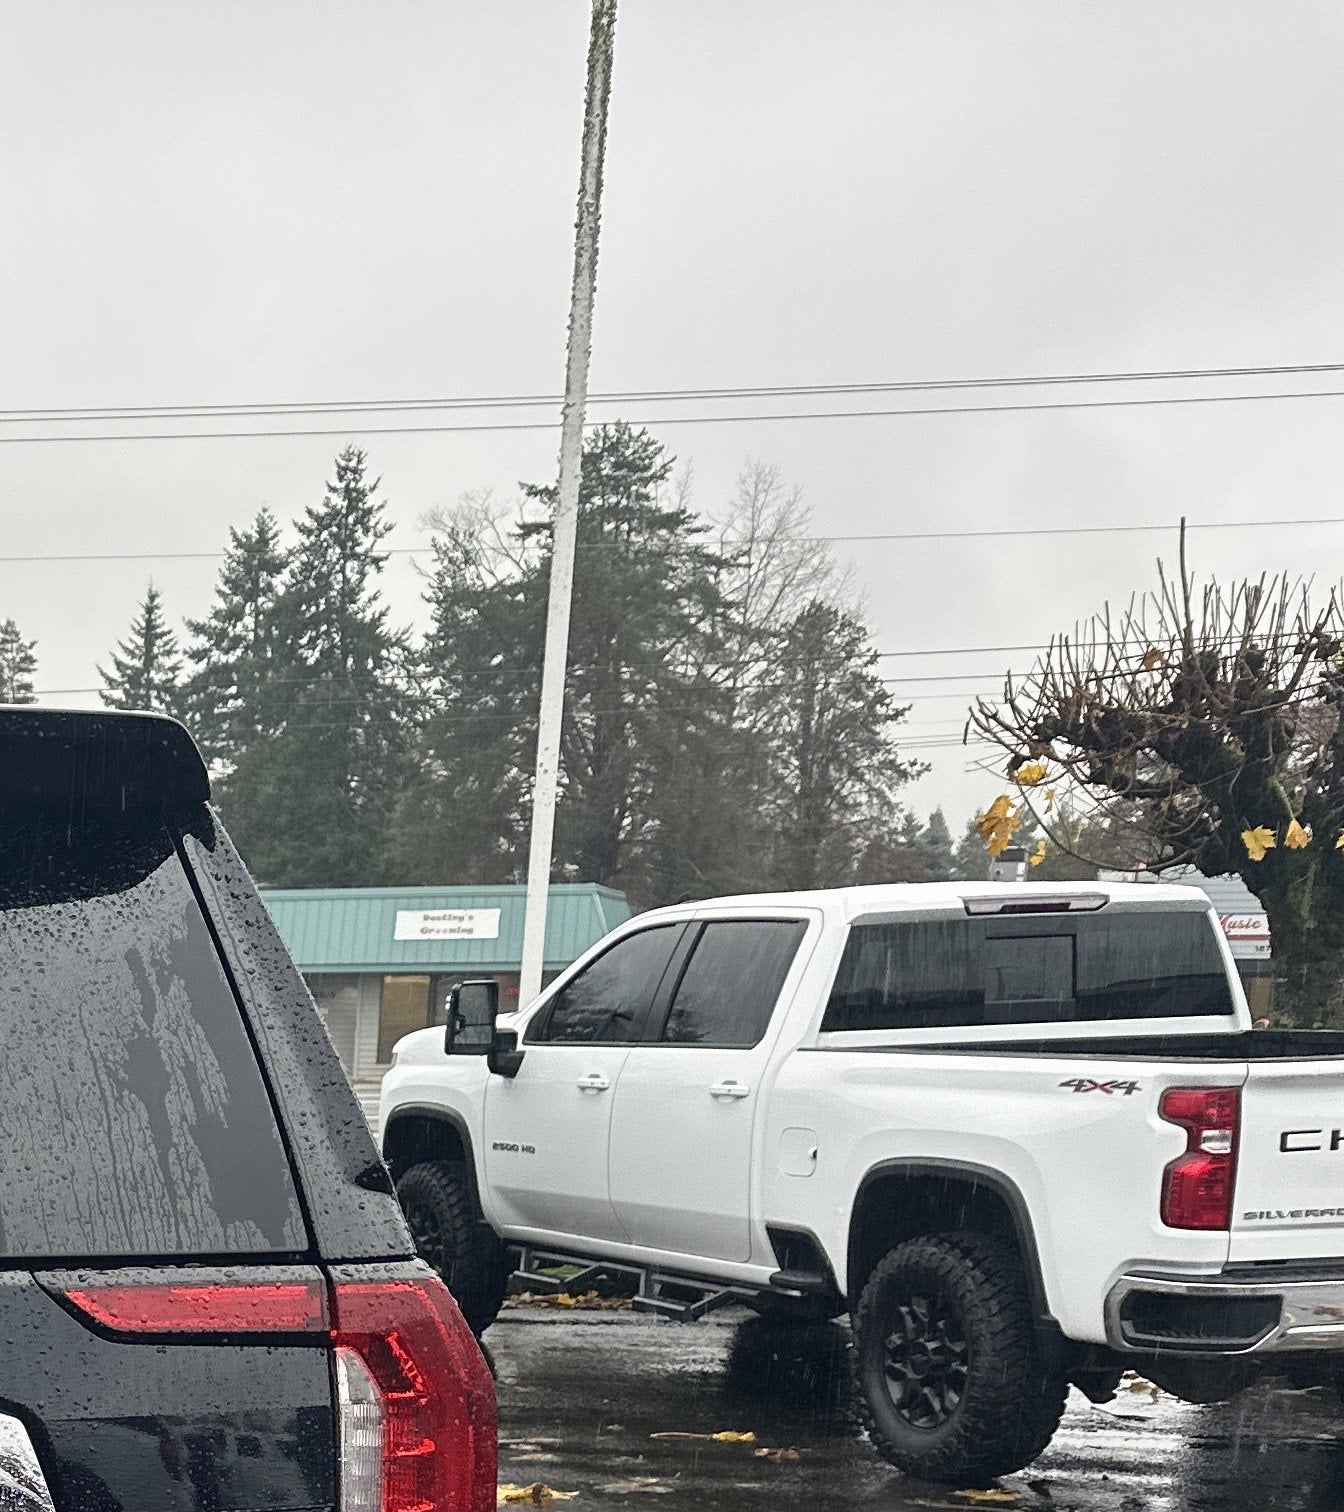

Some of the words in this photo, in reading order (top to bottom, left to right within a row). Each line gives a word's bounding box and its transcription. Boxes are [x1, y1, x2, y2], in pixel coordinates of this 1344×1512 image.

[420, 926, 474, 934] Grooming
[492, 1142, 519, 1152] 2500
[521, 1144, 536, 1154] HD
